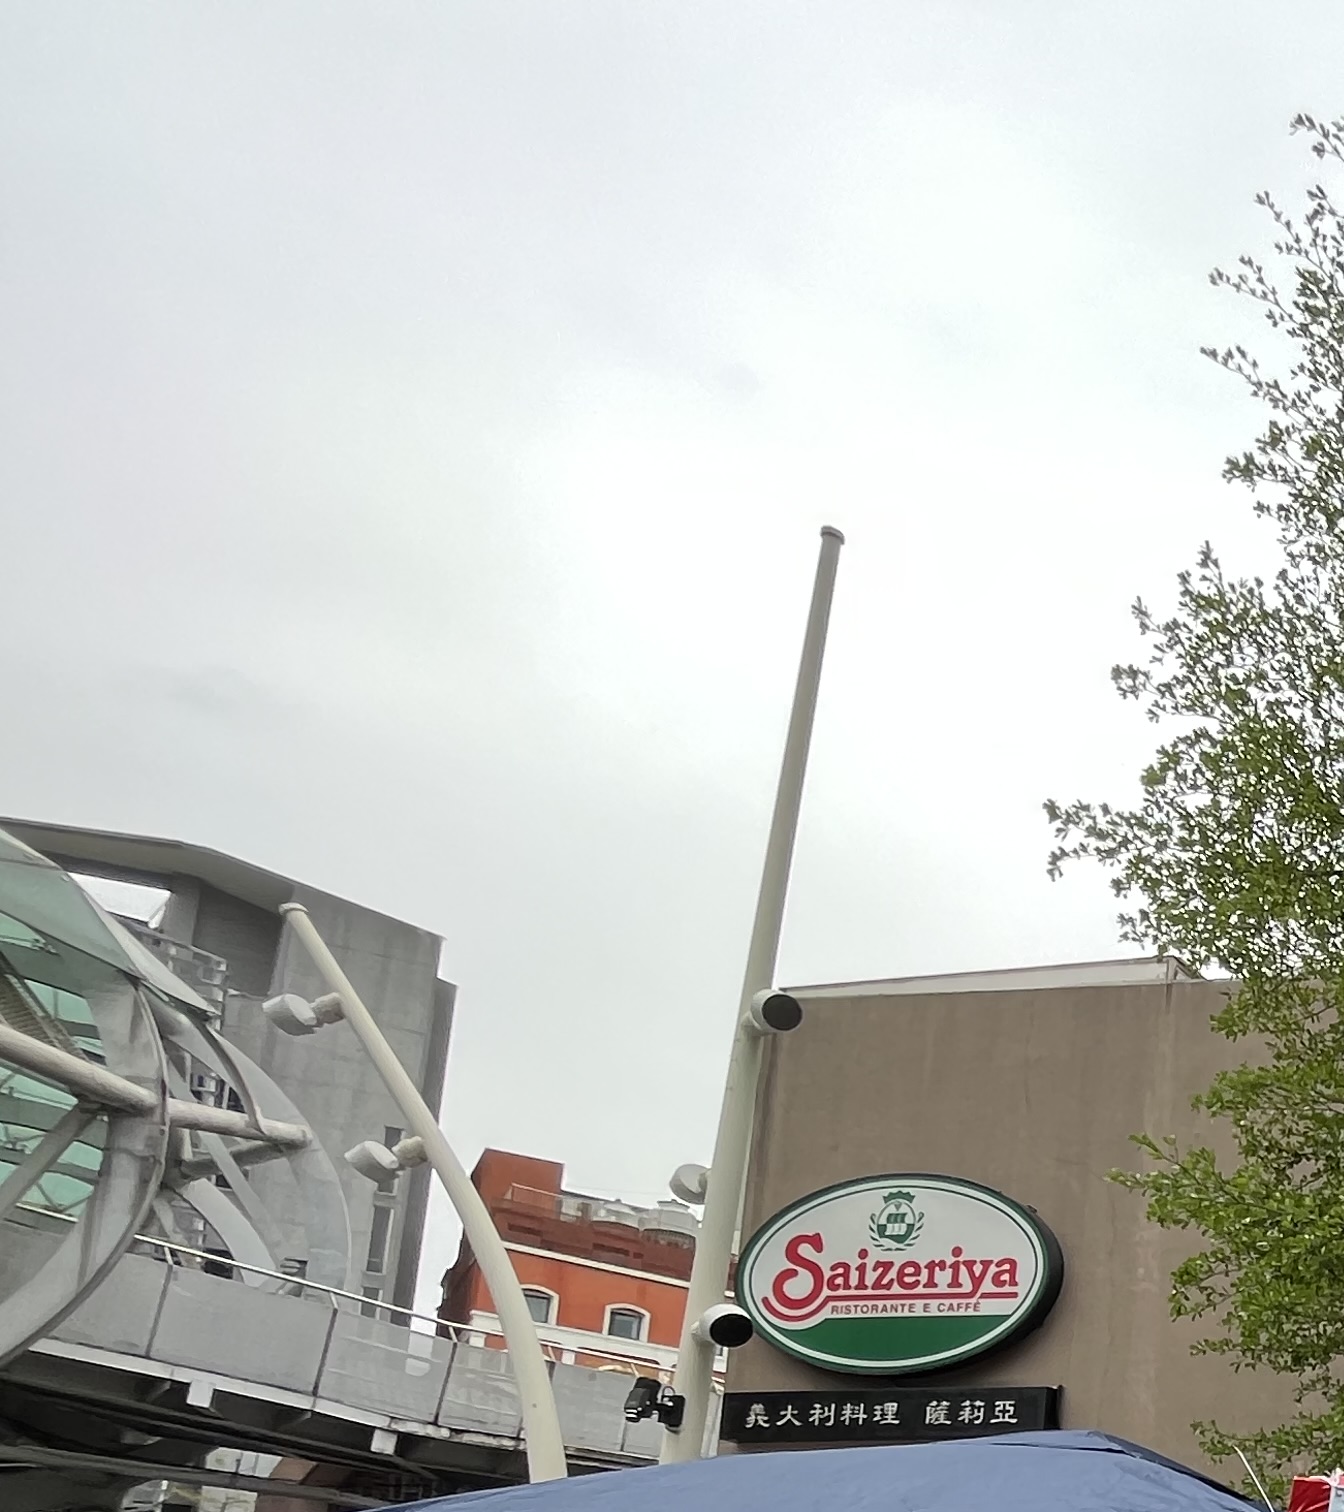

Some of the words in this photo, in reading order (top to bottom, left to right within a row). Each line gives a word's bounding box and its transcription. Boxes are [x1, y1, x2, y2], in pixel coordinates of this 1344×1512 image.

[766, 1232, 1020, 1318] Saizeriya
[831, 1302, 917, 1315] RISTORANTE
[923, 1302, 932, 1313] E
[744, 1402, 901, 1428] 義大利料理
[924, 1399, 1018, 1425] 薩莉亞
